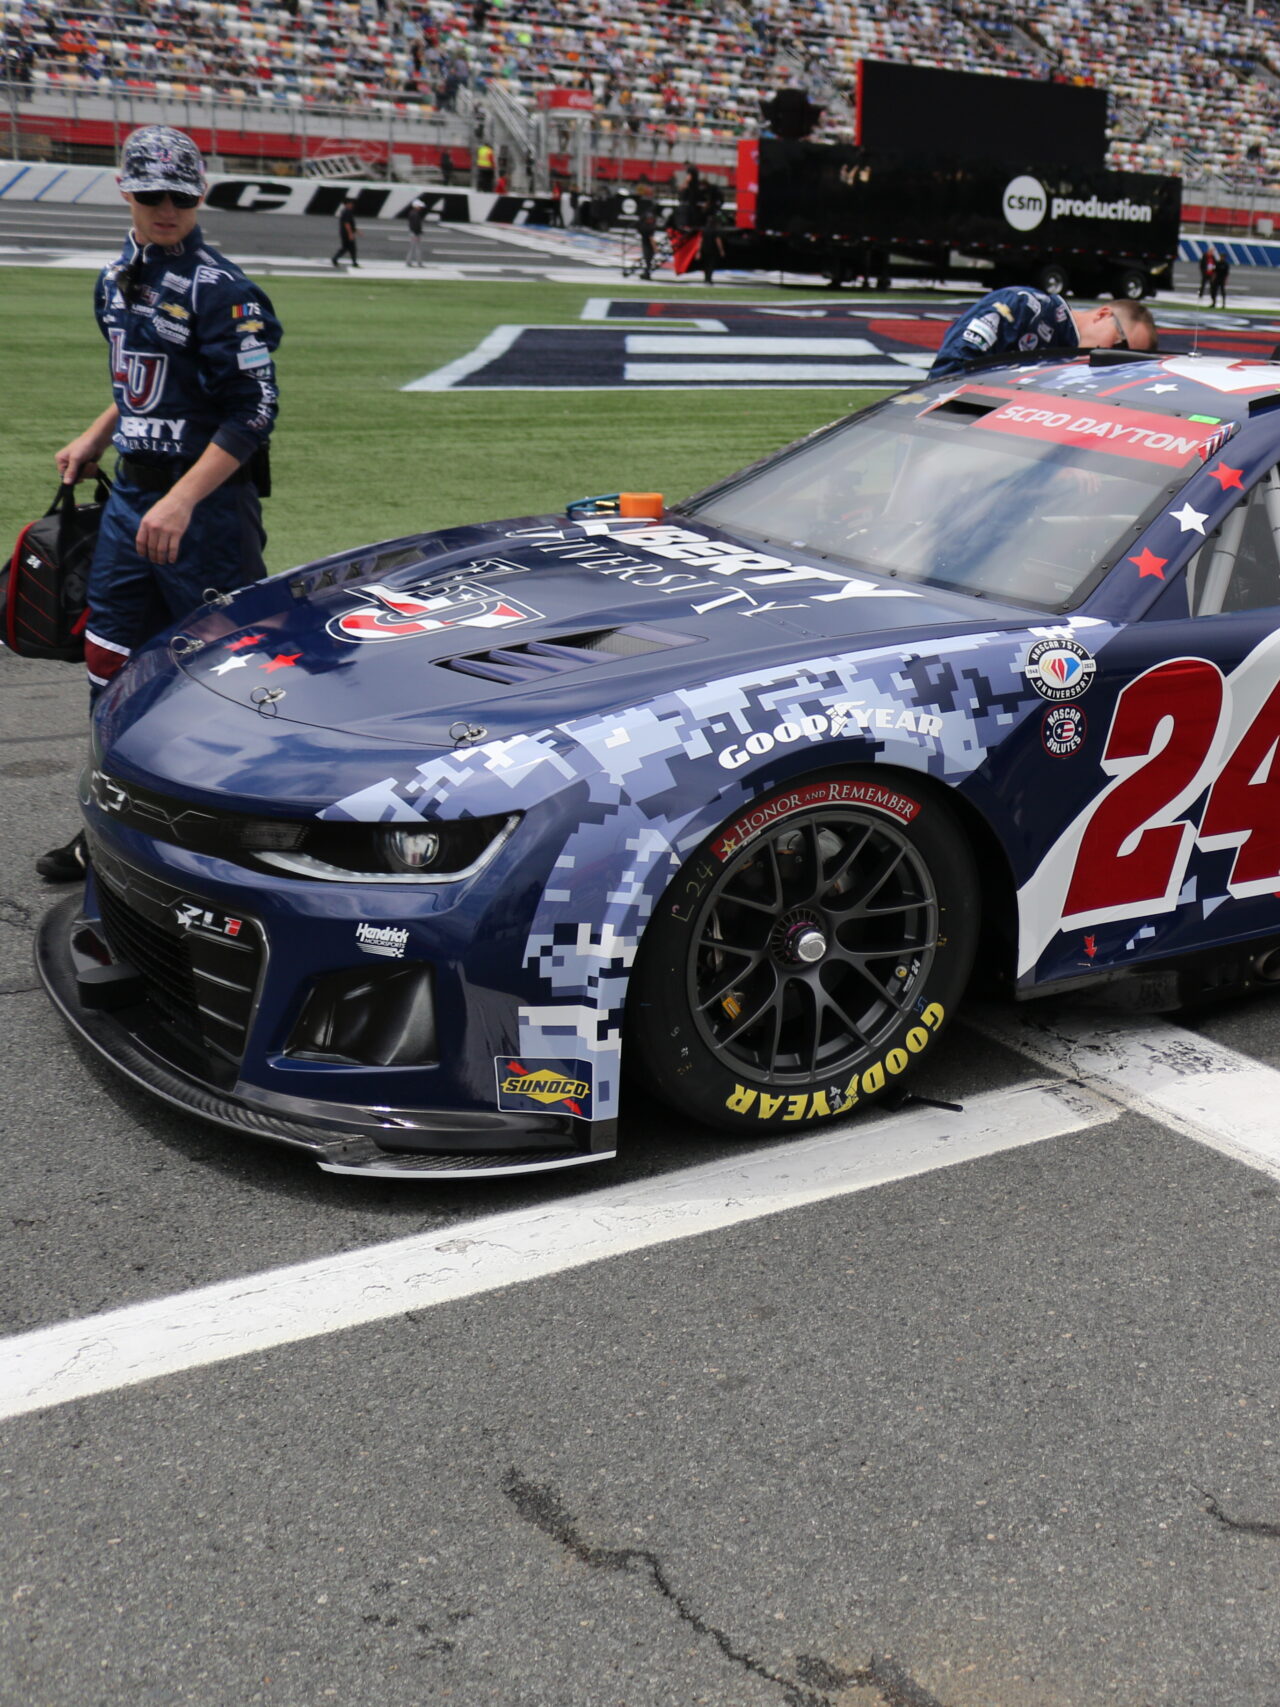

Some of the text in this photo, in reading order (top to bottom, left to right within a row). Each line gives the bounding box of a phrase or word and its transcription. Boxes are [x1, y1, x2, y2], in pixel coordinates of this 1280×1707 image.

[1007, 195, 1043, 212] csm
[1051, 195, 1152, 222] production
[1000, 406, 1198, 454] SCPO DAYTON
[1031, 641, 1084, 661] NASCAR 75TH
[1036, 674, 1090, 699] ANNIVERSARY
[1047, 707, 1081, 726] NASCAR
[718, 702, 943, 769] GOODYEAR
[1046, 735, 1081, 754] SALUTES
[734, 783, 915, 838] HONOR AND REMEMBER
[355, 922, 410, 944] Hendrick
[363, 939, 406, 949] MOTORSPORTS
[725, 1002, 945, 1121] GOODYEAR
[505, 1078, 587, 1098] SUNOCO
